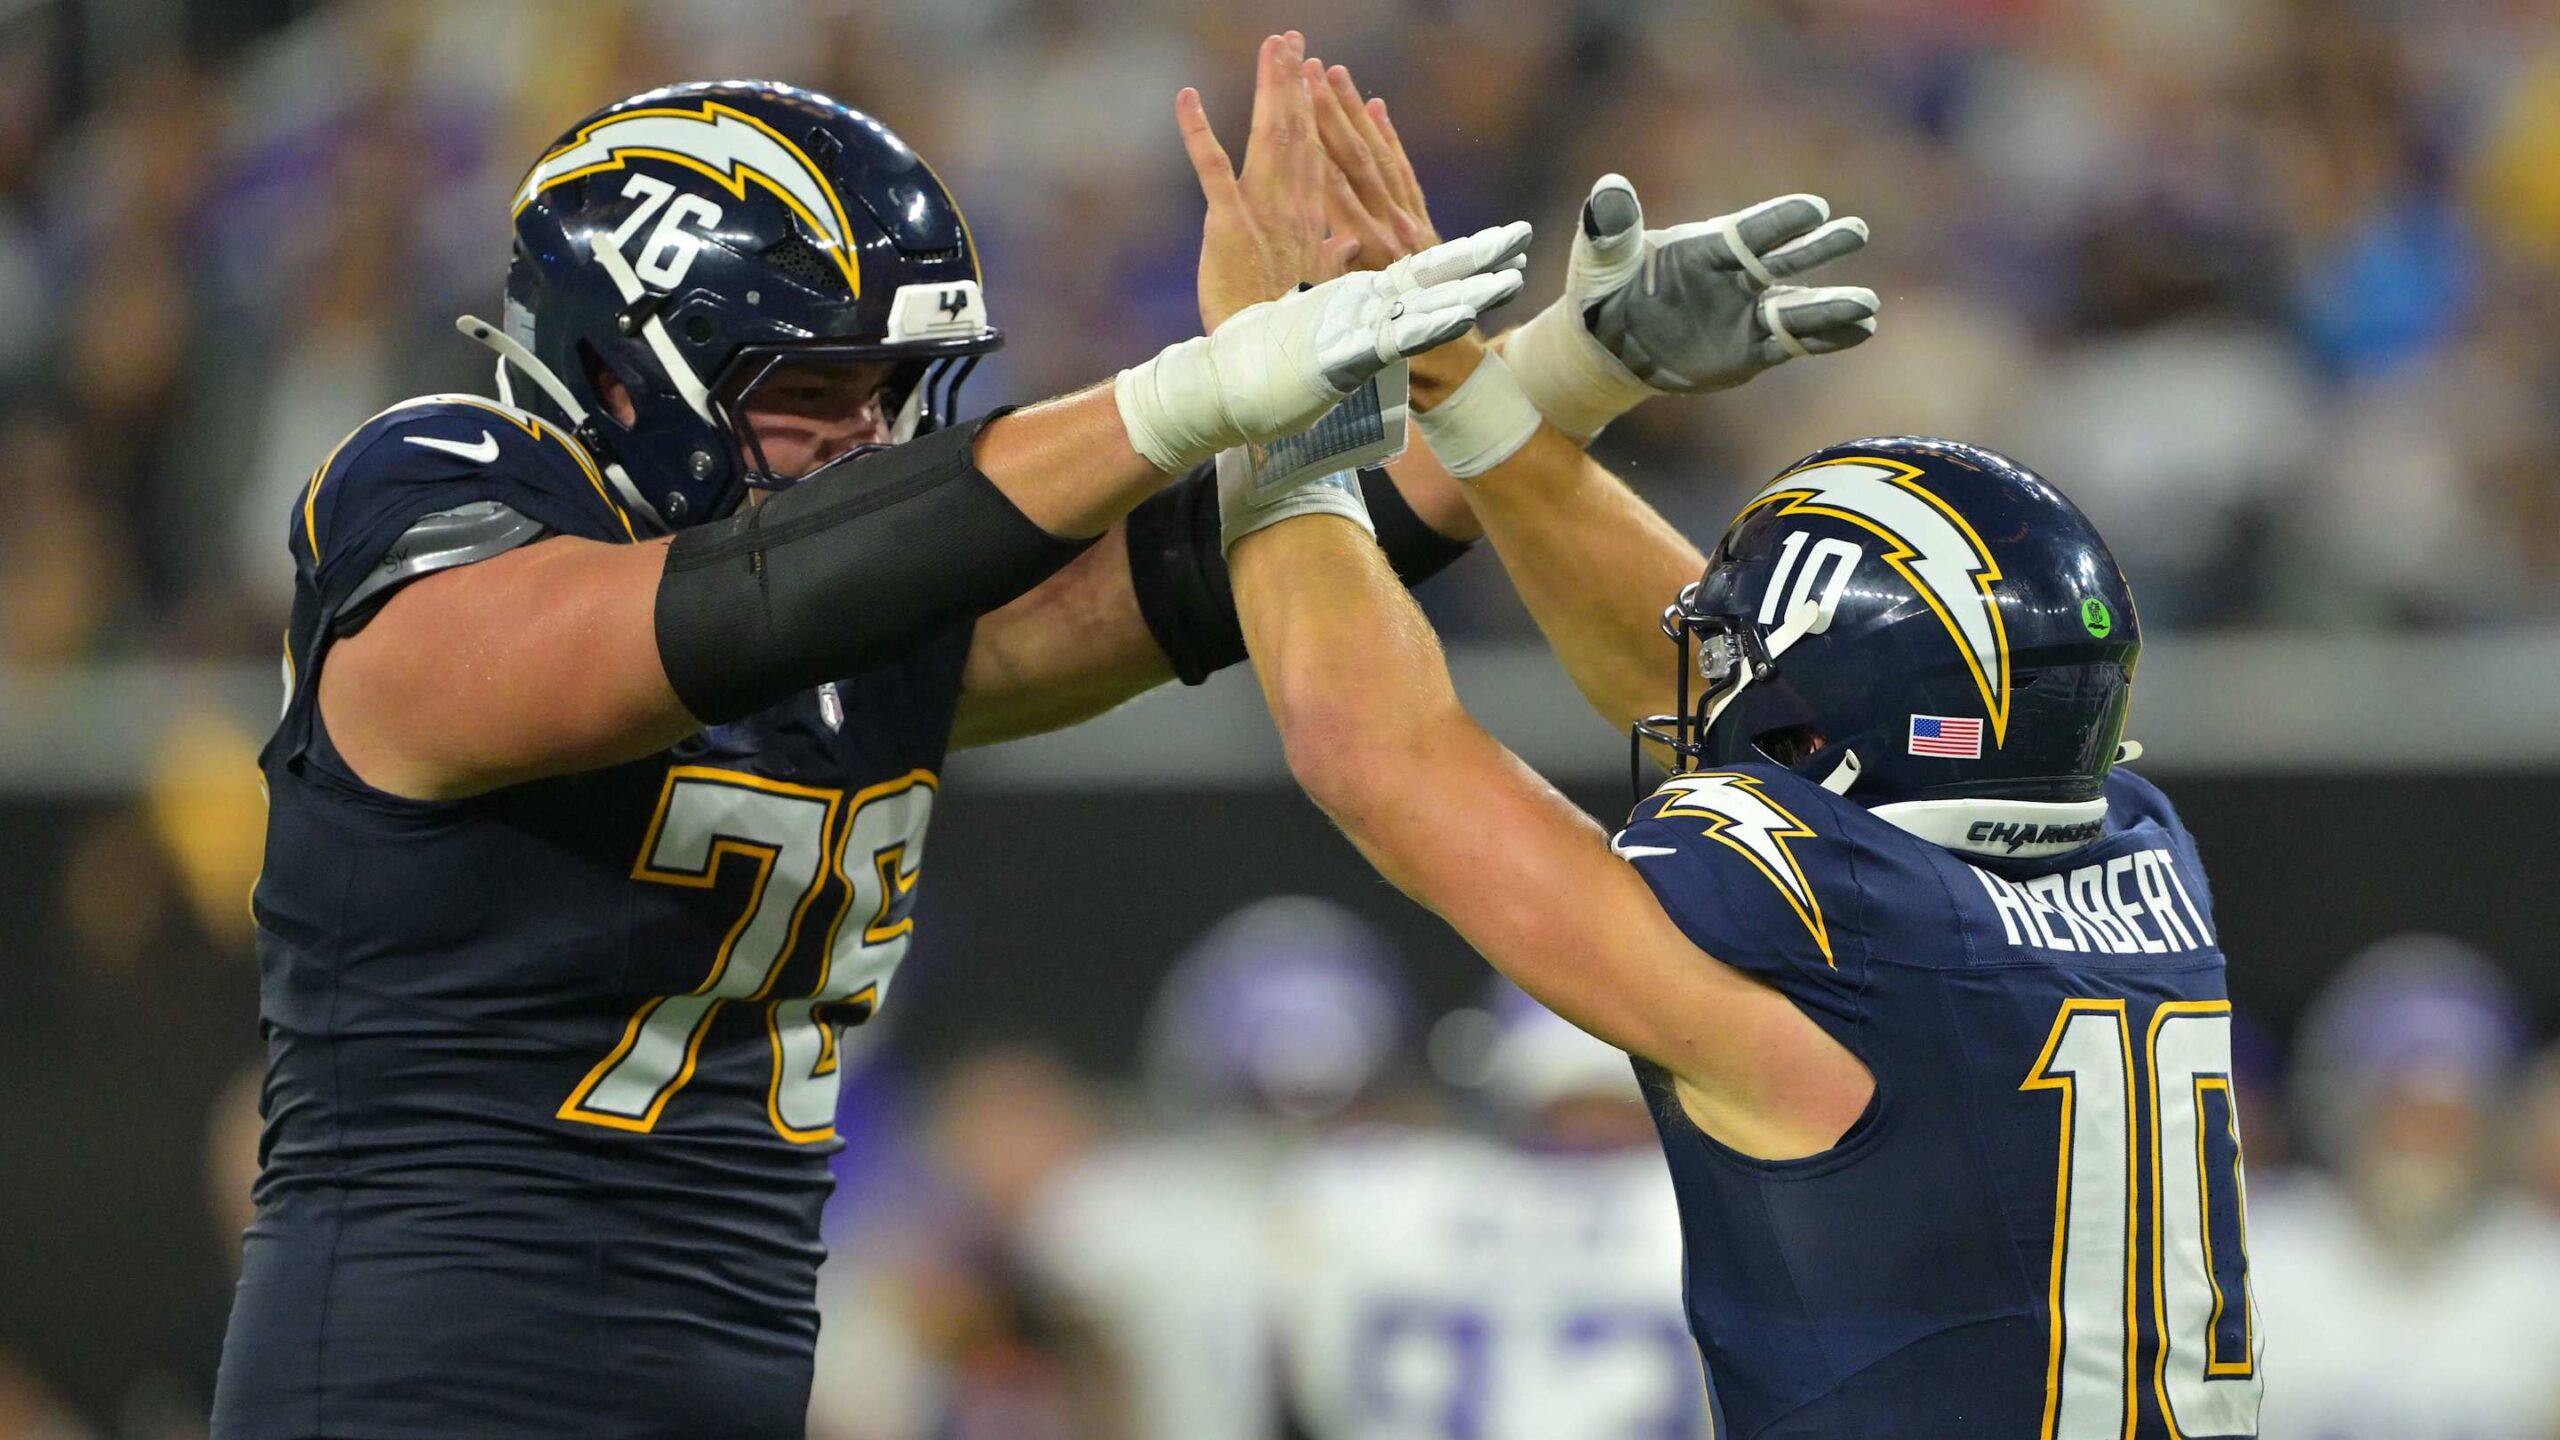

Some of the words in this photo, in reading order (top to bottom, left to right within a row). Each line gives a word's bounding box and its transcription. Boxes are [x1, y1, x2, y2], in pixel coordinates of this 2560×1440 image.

[609, 172, 724, 290] 76
[1757, 530, 1863, 635] 10
[556, 765, 939, 1145] 76
[1967, 848, 2215, 955] HERBERT
[2018, 997, 2265, 1440] 10
